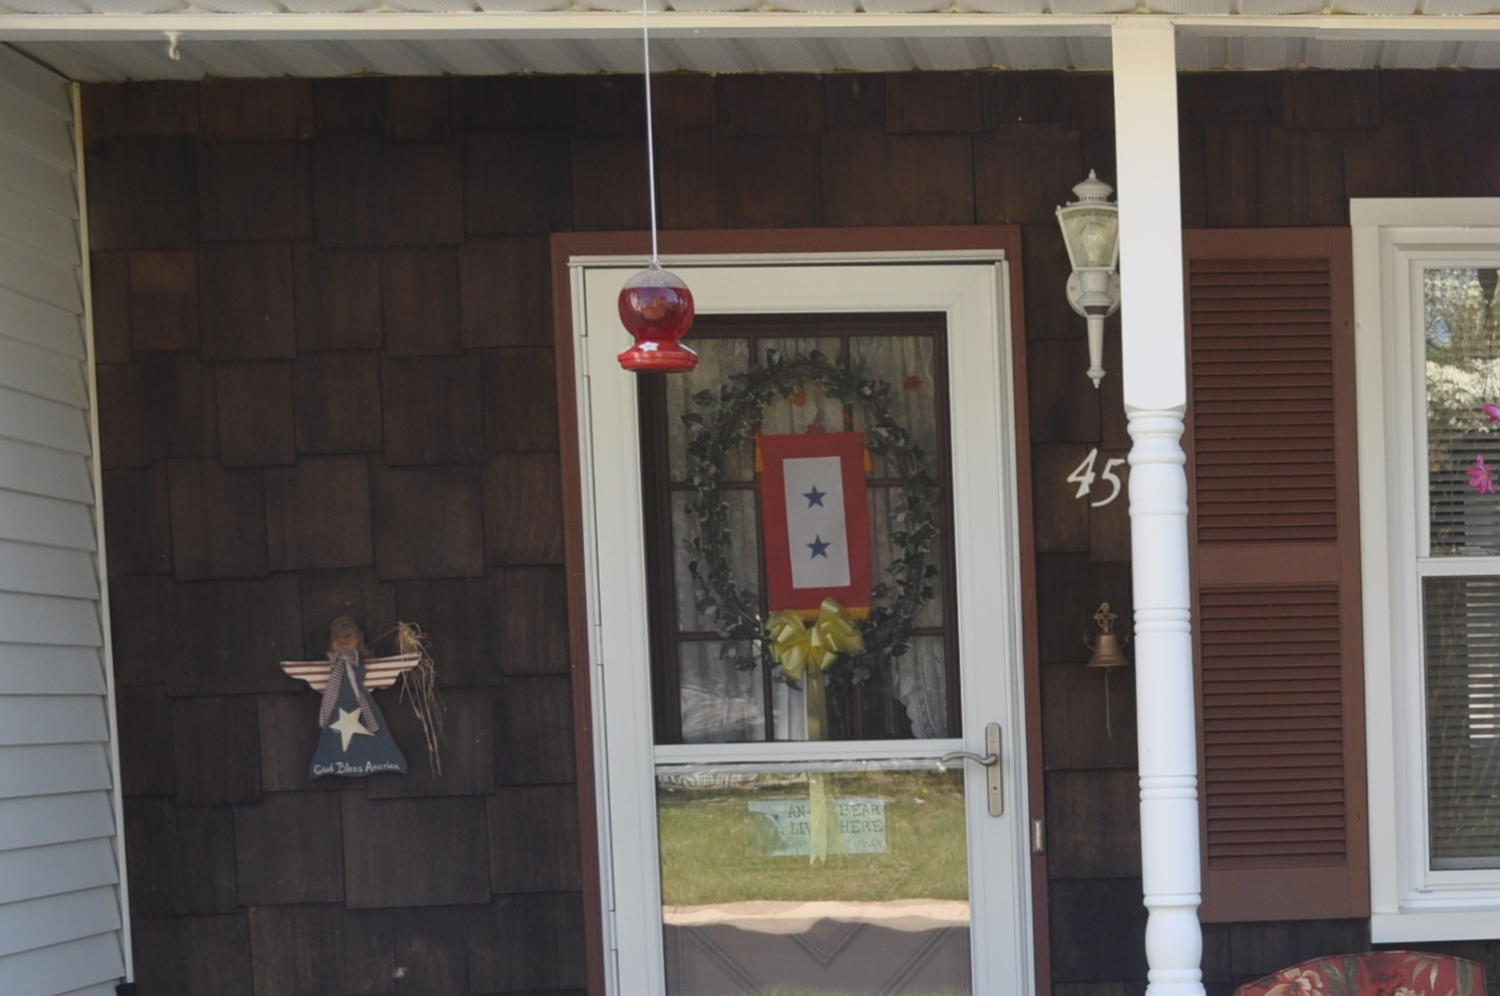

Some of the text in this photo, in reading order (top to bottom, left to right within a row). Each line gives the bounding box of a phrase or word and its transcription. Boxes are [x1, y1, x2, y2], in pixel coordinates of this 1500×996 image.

[1067, 448, 1126, 507] 45
[788, 805, 806, 818] AN
[838, 802, 881, 816] BEAR
[840, 819, 883, 833] HERE
